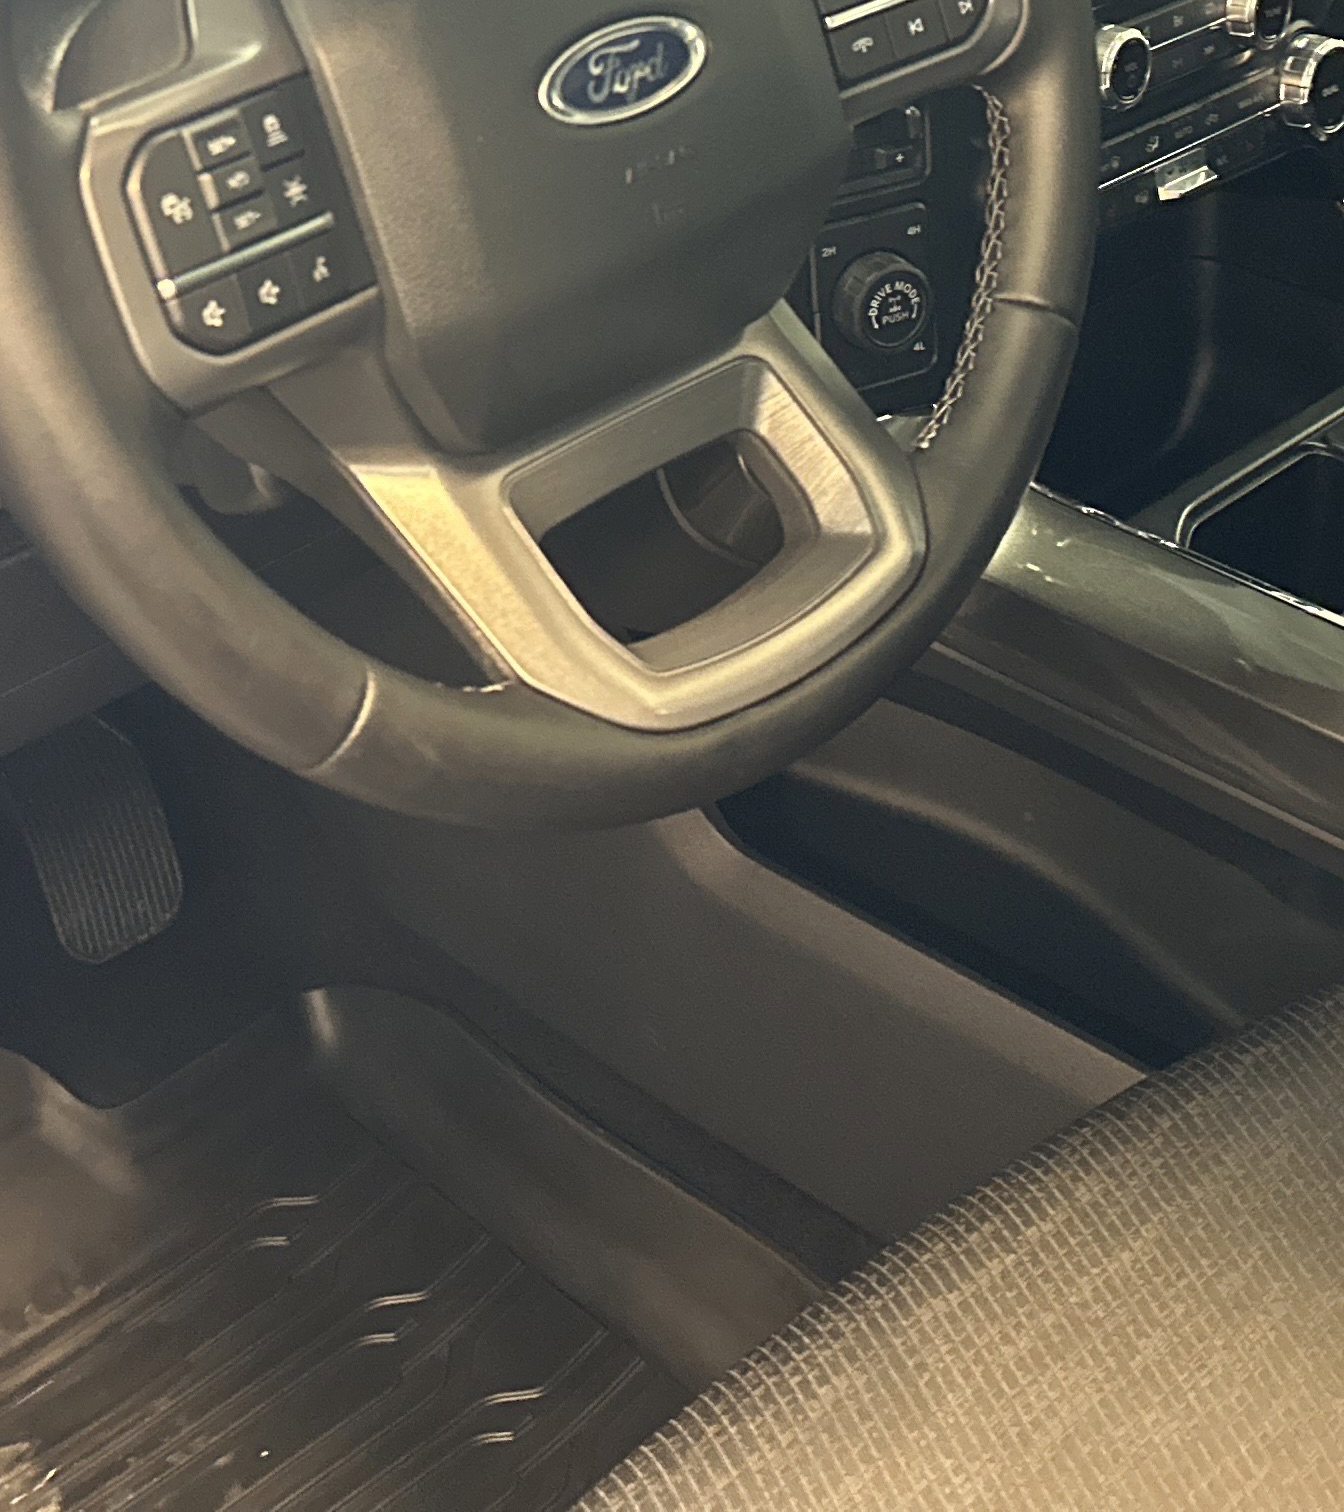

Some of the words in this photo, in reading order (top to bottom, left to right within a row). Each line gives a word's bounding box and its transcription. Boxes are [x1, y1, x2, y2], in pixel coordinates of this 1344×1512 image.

[587, 38, 666, 104] Ford
[820, 246, 836, 258] 2H
[867, 283, 893, 317] DRIVE
[894, 281, 920, 304] MODE
[881, 310, 908, 324] PUSH
